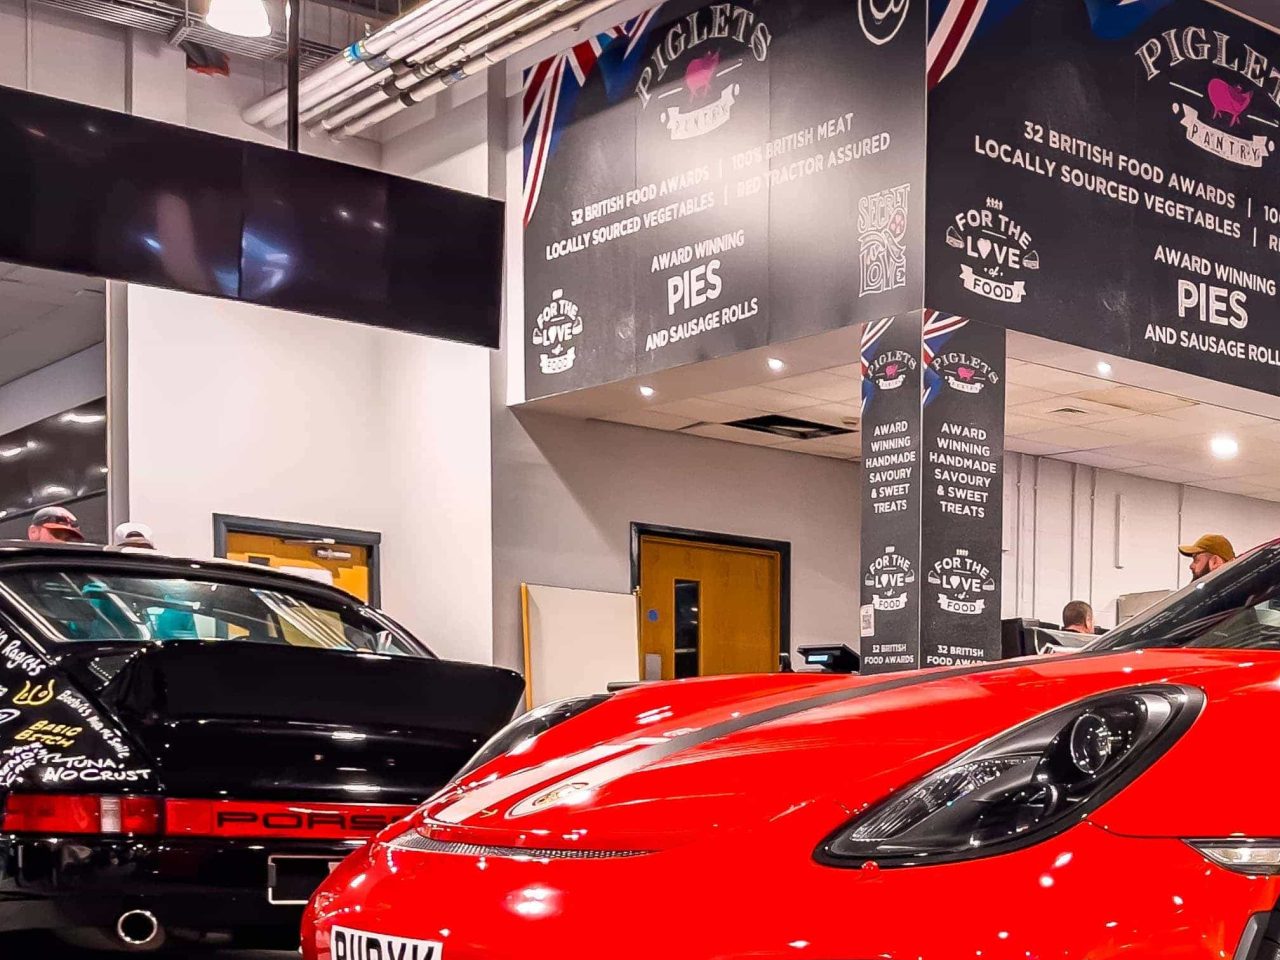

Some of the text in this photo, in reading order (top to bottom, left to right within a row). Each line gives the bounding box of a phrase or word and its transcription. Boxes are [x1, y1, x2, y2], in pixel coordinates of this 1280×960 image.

[1191, 123, 1260, 161] PANTRY
[571, 208, 583, 226] 32
[585, 195, 624, 221] BRITISH
[626, 184, 657, 207] FOOD
[659, 166, 709, 196] AWARDS
[767, 128, 814, 158] BRITISH
[817, 113, 853, 140] MEAT
[1024, 121, 1043, 143] 32
[1049, 130, 1113, 167] BRITISH
[1119, 155, 1163, 184] FOOD
[1168, 173, 1236, 209] AWARDS
[546, 132, 891, 260] LOCALLY SOURCED VEGETABLES RED TRACTOR ASSURED
[975, 135, 1056, 178] LOCALLY
[1060, 165, 1139, 205] SOURCED
[1144, 192, 1241, 238] VEGETABLES
[955, 209, 1032, 250] FOR THE
[651, 229, 744, 273] AWARD WINNING
[1154, 244, 1276, 296] AWARD WINNING
[667, 259, 722, 315] PIES
[973, 278, 1013, 299] FOOD
[1178, 279, 1248, 329] PIES
[537, 299, 578, 329] FOR THE
[645, 297, 758, 351] AND SAUSAGE ROLLS
[1144, 324, 1177, 344] AND
[1180, 331, 1245, 359] SAUSAGE
[874, 421, 908, 436] AWARD
[941, 422, 986, 440] AWARD
[871, 436, 911, 452] WINNING
[937, 437, 990, 456] WINNING
[865, 451, 916, 468] HANDMADE
[929, 452, 997, 473] HANDMADE
[869, 467, 912, 483] SAVOURY
[934, 468, 991, 487] SAVOURY
[871, 483, 910, 498] & SWEET
[937, 485, 989, 503] & SWEET
[874, 500, 907, 513] TREATS
[940, 501, 985, 518] TREATS
[870, 554, 910, 574] FOR THE
[934, 557, 989, 579] FOR THE
[878, 600, 900, 608] FOOD
[947, 601, 976, 612] FOOD
[881, 644, 906, 652] BRITISH
[937, 645, 984, 657] 32 BRITISH
[864, 655, 914, 664] FOOD AWARDS
[926, 656, 952, 665] FOOD
[216, 811, 398, 828] PORS
